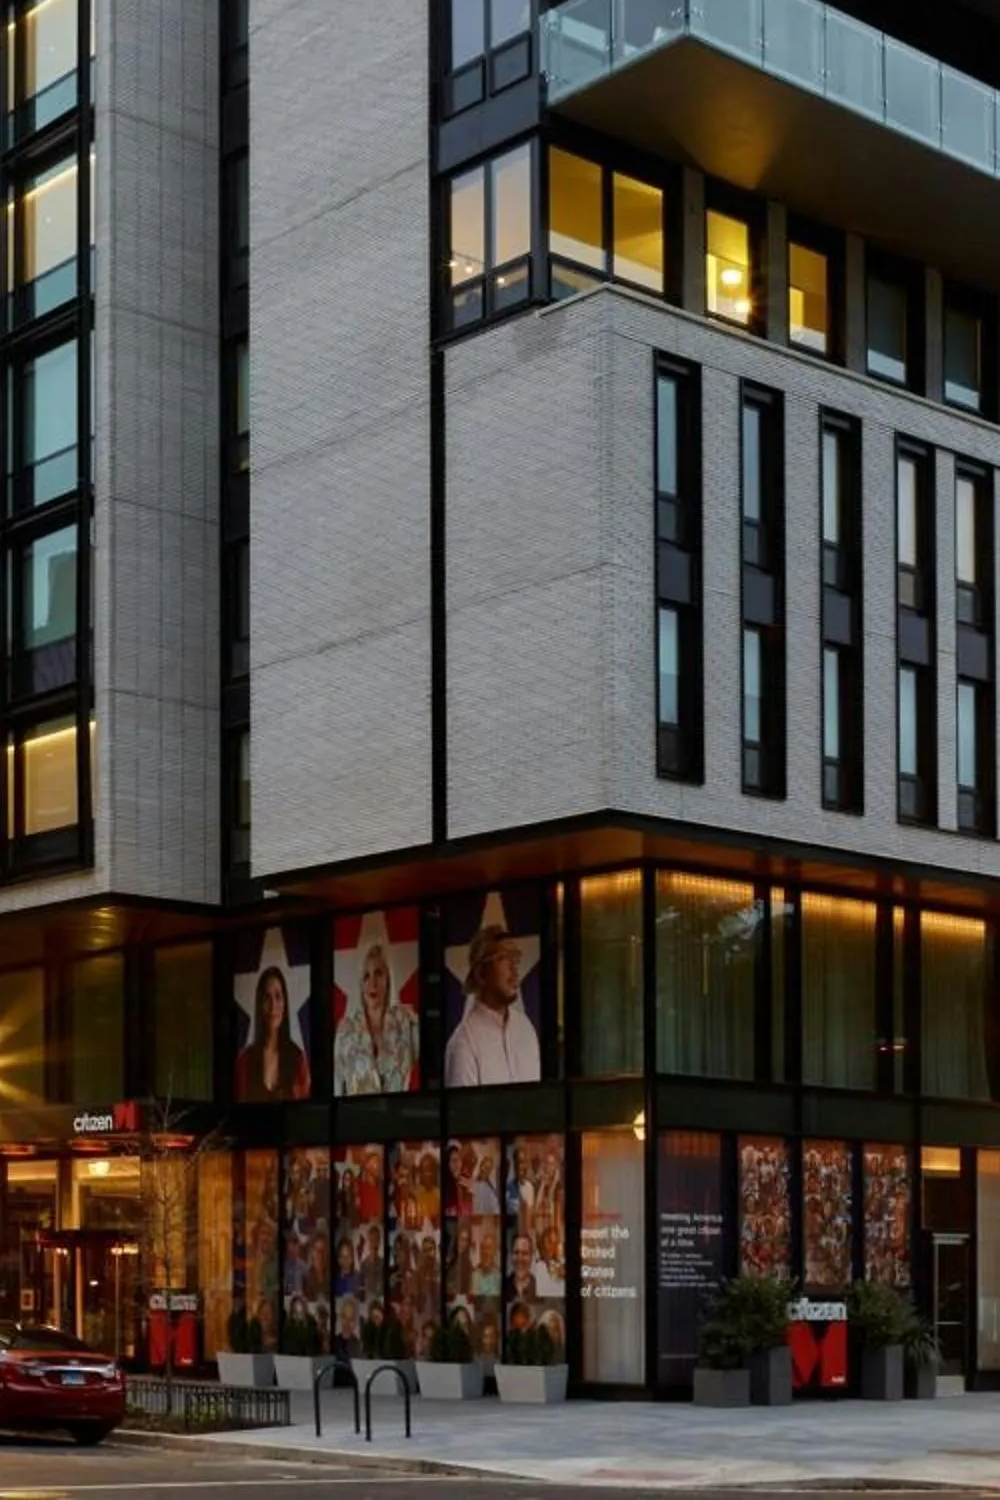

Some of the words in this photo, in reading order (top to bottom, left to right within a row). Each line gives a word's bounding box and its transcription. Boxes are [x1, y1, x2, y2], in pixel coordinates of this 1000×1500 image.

[611, 1225, 630, 1239] the
[581, 1246, 616, 1259] United
[581, 1265, 615, 1279] States
[580, 1284, 591, 1298] of
[593, 1284, 638, 1299] citizens
[786, 1297, 847, 1320] citizen
